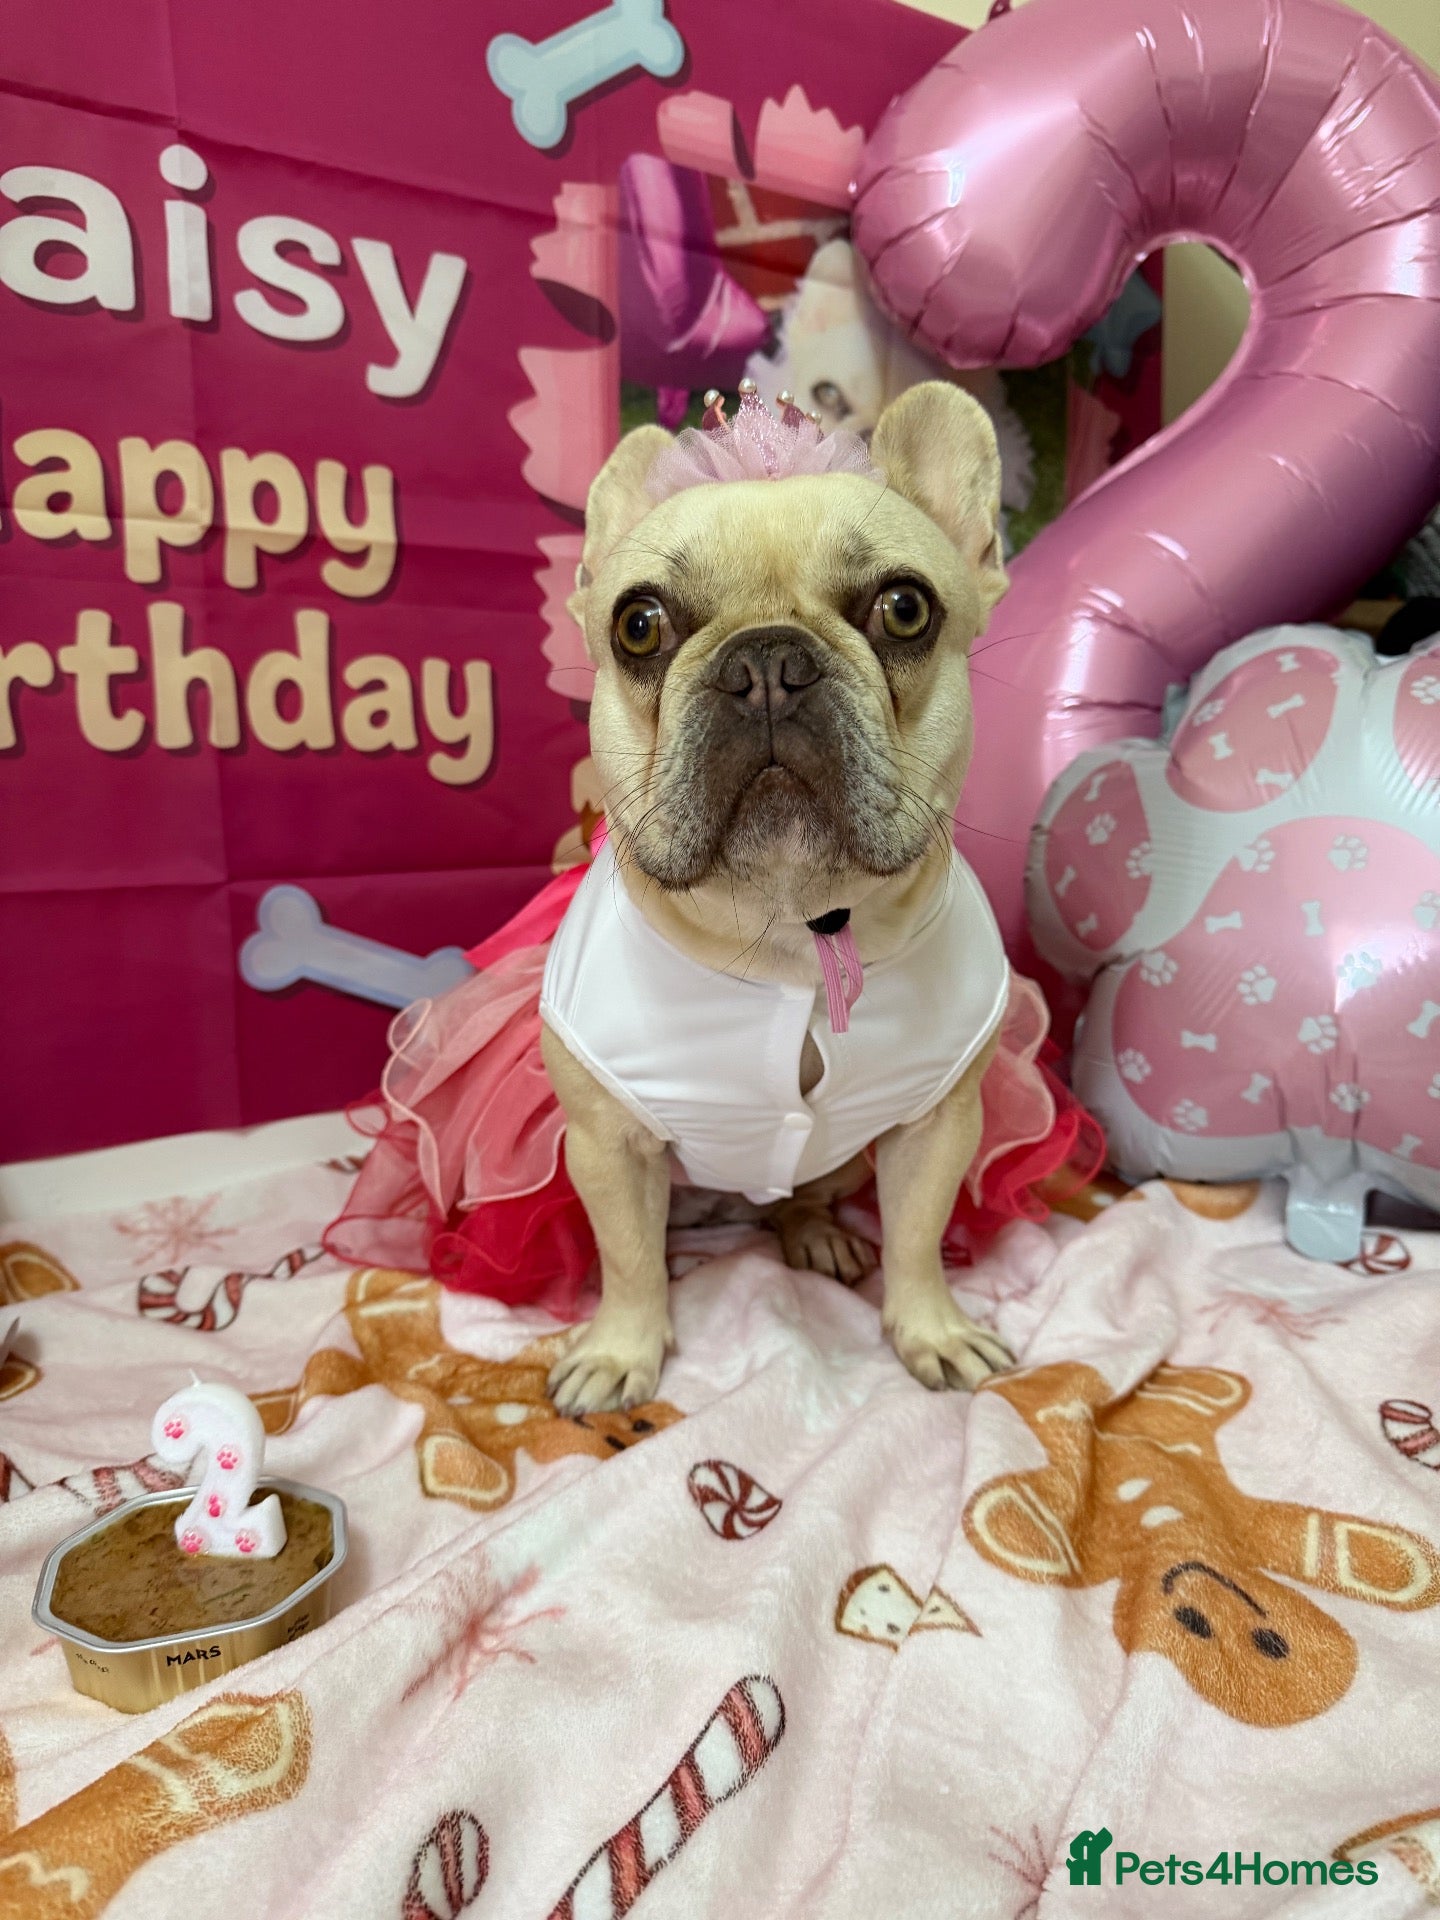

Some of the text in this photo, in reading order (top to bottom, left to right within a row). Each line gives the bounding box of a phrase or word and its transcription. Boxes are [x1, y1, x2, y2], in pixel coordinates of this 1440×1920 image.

[0, 144, 467, 398] aisy
[0, 428, 397, 597] appy
[0, 602, 493, 784] rthday
[152, 1381, 288, 1559] 2
[166, 1645, 222, 1667] MARS
